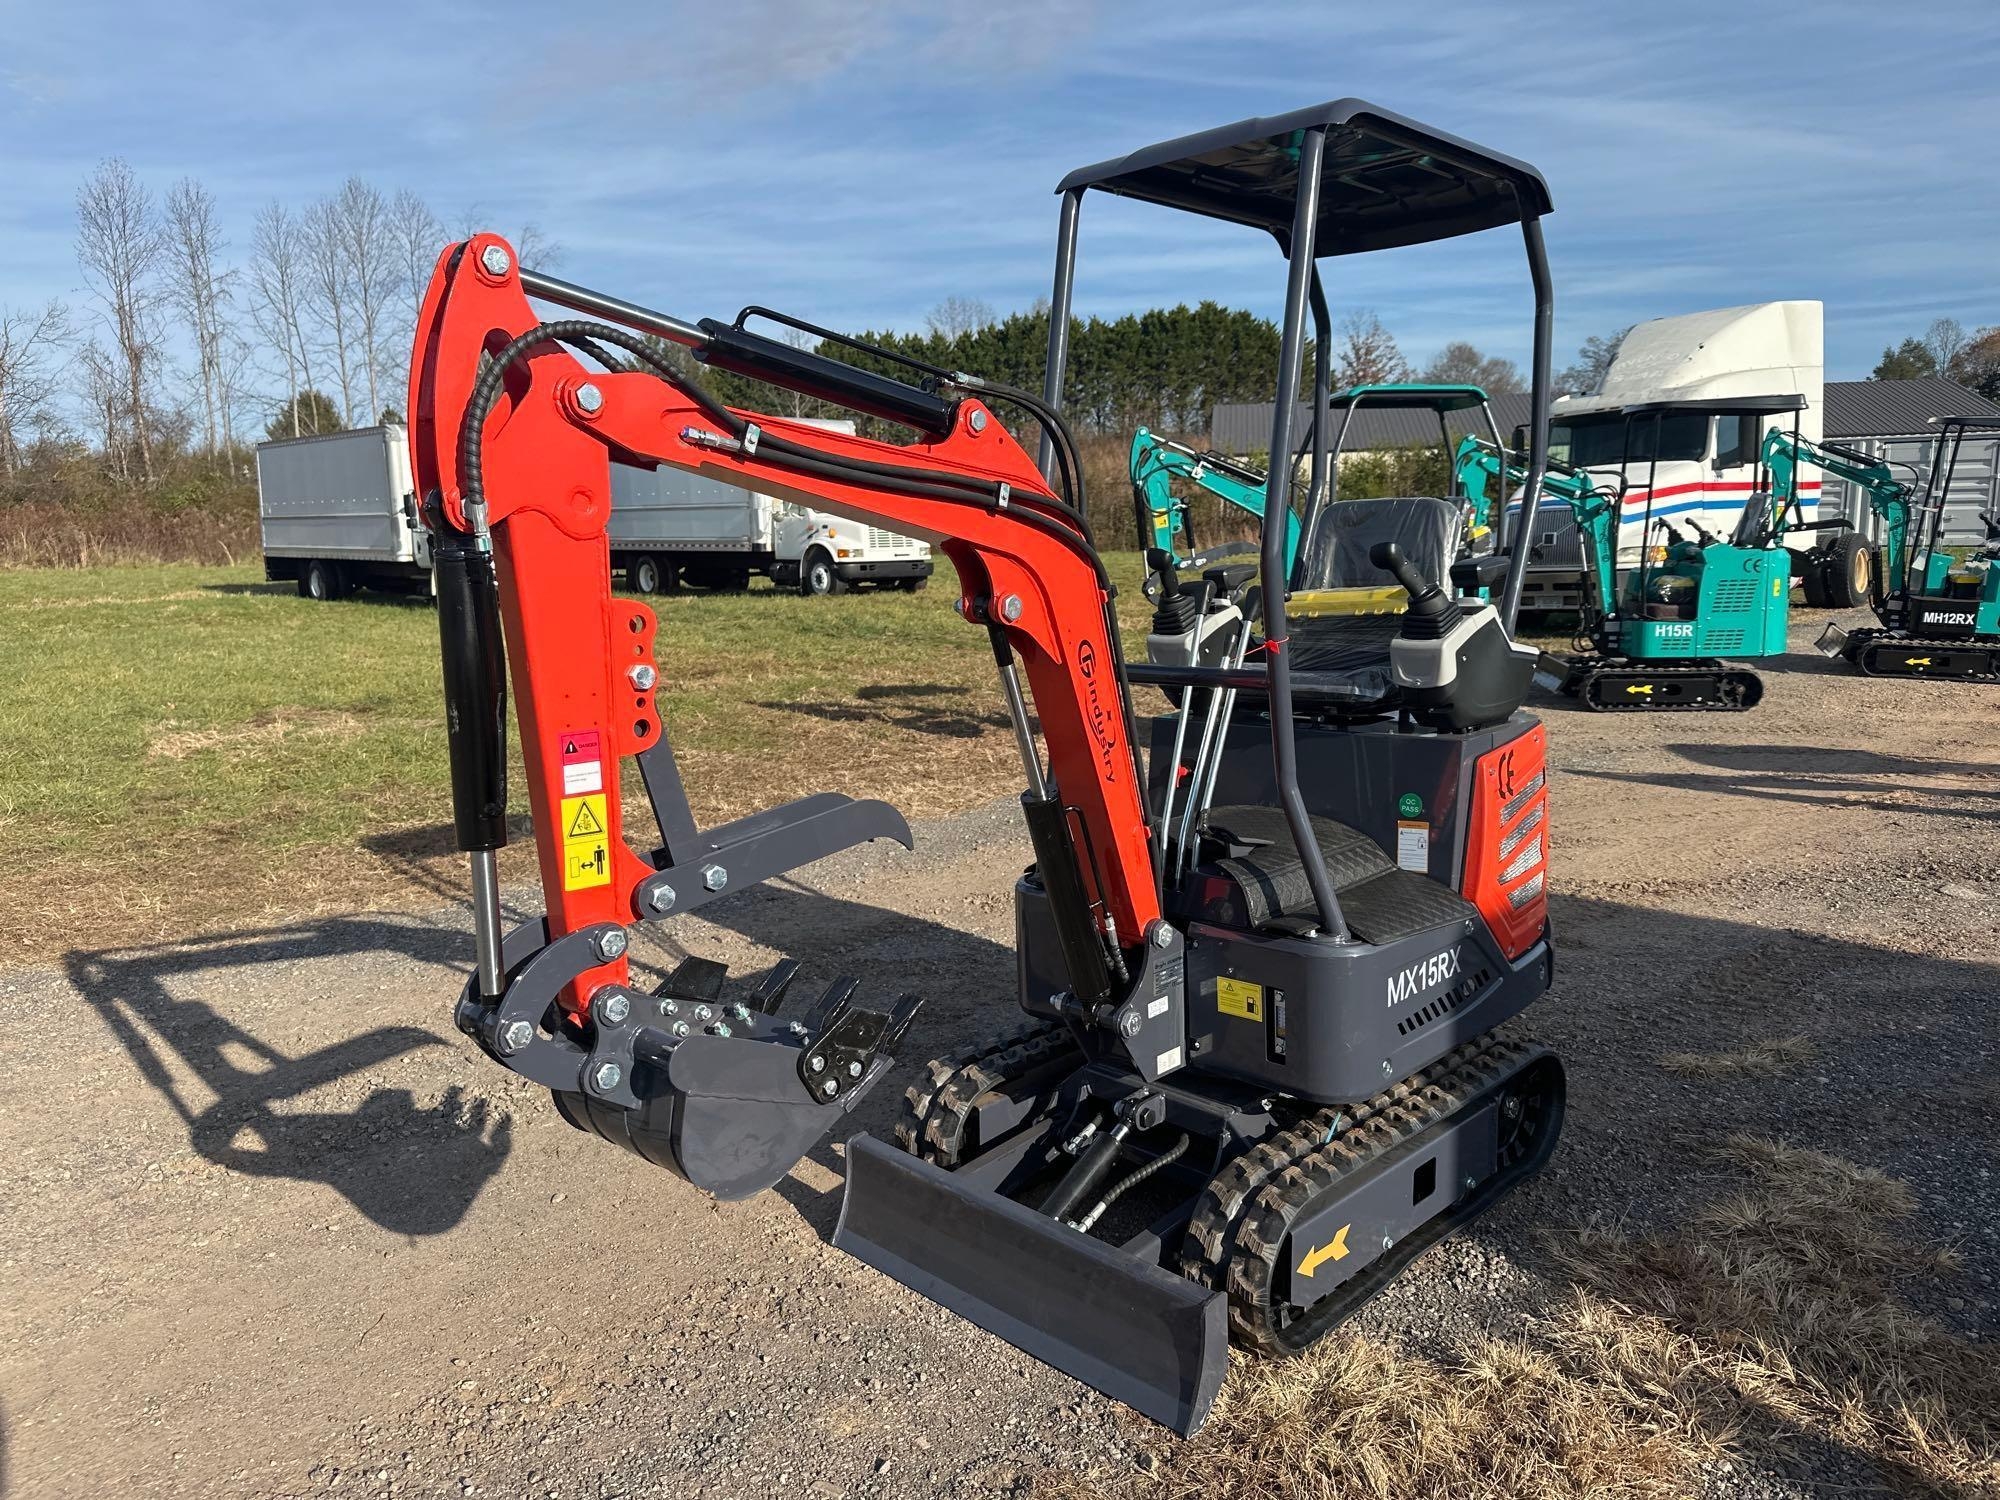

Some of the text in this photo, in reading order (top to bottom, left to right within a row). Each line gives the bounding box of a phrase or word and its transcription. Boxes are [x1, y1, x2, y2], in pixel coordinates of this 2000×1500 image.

[1923, 611, 1976, 625] MH12RX
[1655, 624, 1694, 637] H15R
[1405, 798, 1416, 806] QC
[1401, 805, 1420, 813] PASS
[1387, 944, 1462, 1008] MX15RX
